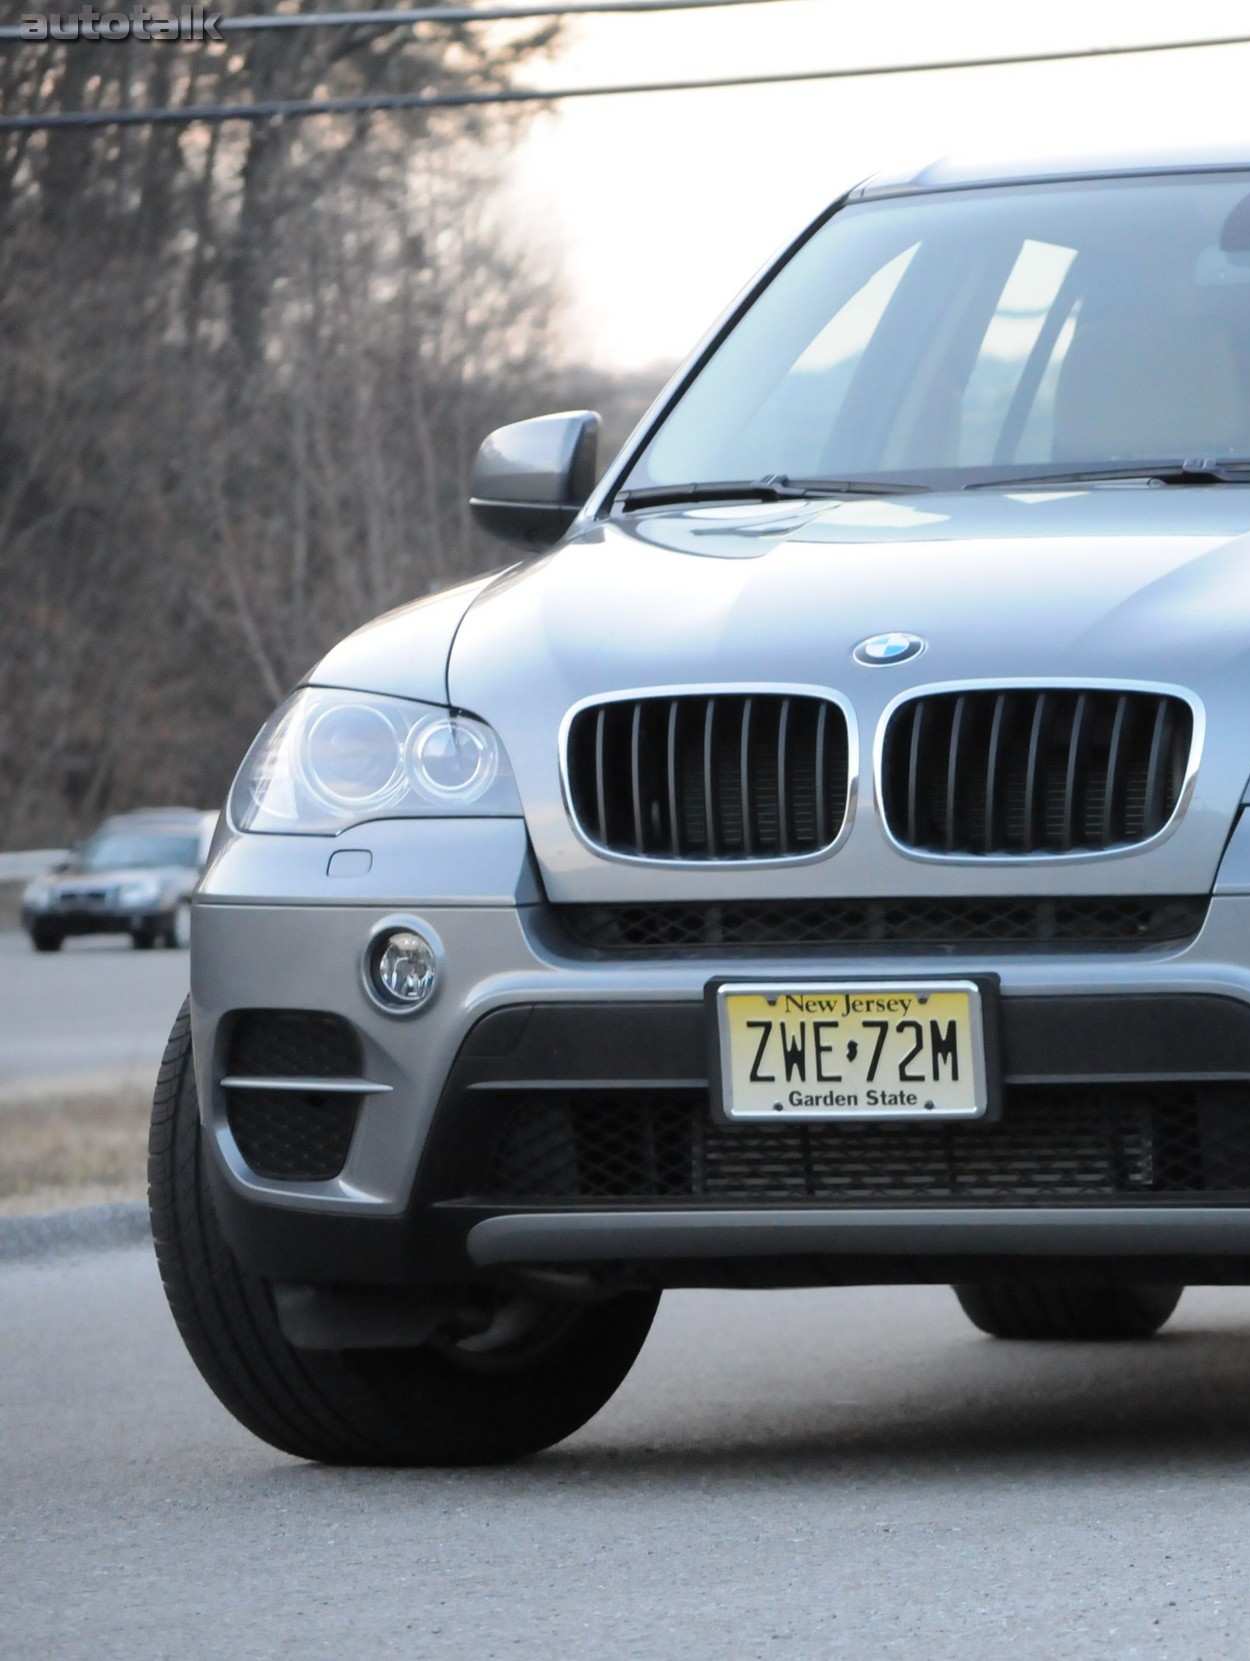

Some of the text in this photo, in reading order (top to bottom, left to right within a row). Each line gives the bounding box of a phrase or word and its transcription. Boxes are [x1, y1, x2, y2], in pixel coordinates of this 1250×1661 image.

[785, 994, 912, 1016] New Jersey
[788, 1090, 918, 1107] Garden State
